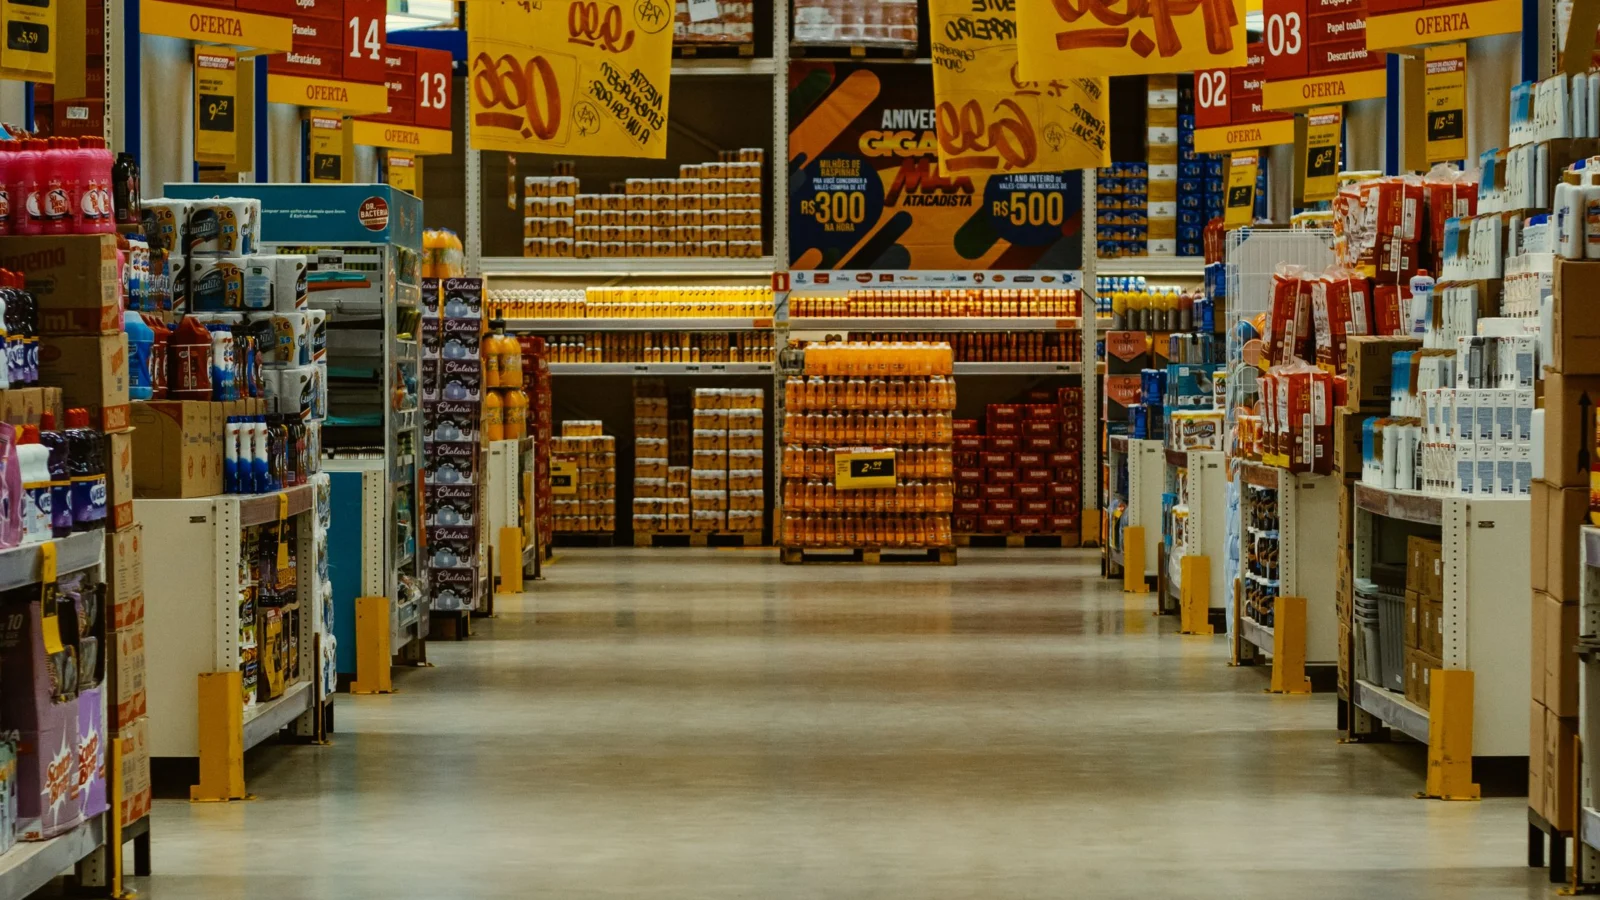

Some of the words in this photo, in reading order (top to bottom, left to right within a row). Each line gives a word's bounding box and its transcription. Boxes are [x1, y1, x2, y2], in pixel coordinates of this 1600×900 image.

[190, 13, 243, 37] OFERTA
[292, 24, 317, 36] Panelas
[1327, 21, 1345, 35] Papel
[1346, 19, 1366, 30] toalha
[1415, 12, 1470, 35] OFERTA
[349, 16, 381, 60] 14
[1267, 12, 1302, 56] 03
[286, 51, 321, 66] Refratários
[1327, 47, 1368, 62] Descartáveis
[420, 72, 446, 109] 13
[1198, 71, 1226, 108] 02
[1243, 79, 1260, 90] Ração
[1302, 80, 1346, 99] OFERTA
[306, 84, 348, 102] OFERTA
[1251, 103, 1261, 113] Pet
[384, 129, 420, 145] OFERTA
[1226, 129, 1262, 144] OFERTA
[858, 130, 938, 157] GIGA
[820, 158, 850, 168] MILHÕES
[851, 159, 861, 168] DE
[820, 168, 860, 177] RASPINHAS
[1014, 174, 1028, 183] ANO
[1029, 174, 1055, 183] INTEIRO
[823, 176, 836, 184] VOCÊ
[885, 158, 975, 207] MAX
[999, 182, 1037, 190] VALES-COMPRA
[1037, 182, 1060, 190] MENSAIS
[1060, 182, 1068, 190] DE
[814, 183, 850, 191] VALES-COMPRA
[857, 183, 866, 191] ATÉ
[903, 195, 972, 207] ATACADISTA
[157, 210, 172, 221] 16
[219, 210, 233, 221] 16
[360, 208, 388, 218] BACTÉRIA
[824, 223, 835, 232] NA
[835, 223, 855, 232] HORA
[223, 267, 239, 278] 16
[446, 278, 481, 291] Chaleira
[275, 321, 291, 332] 16
[444, 319, 479, 332] Chaleira
[1118, 344, 1135, 352] GIN
[445, 360, 480, 373] Chaleira
[1118, 389, 1135, 397] GIN
[436, 401, 472, 414] Chaleira
[437, 443, 472, 456] Chaleira
[860, 460, 883, 473] 2,99
[437, 485, 472, 498] Chaleira
[434, 527, 470, 540] Chaleira
[437, 569, 472, 582] Chaleira
